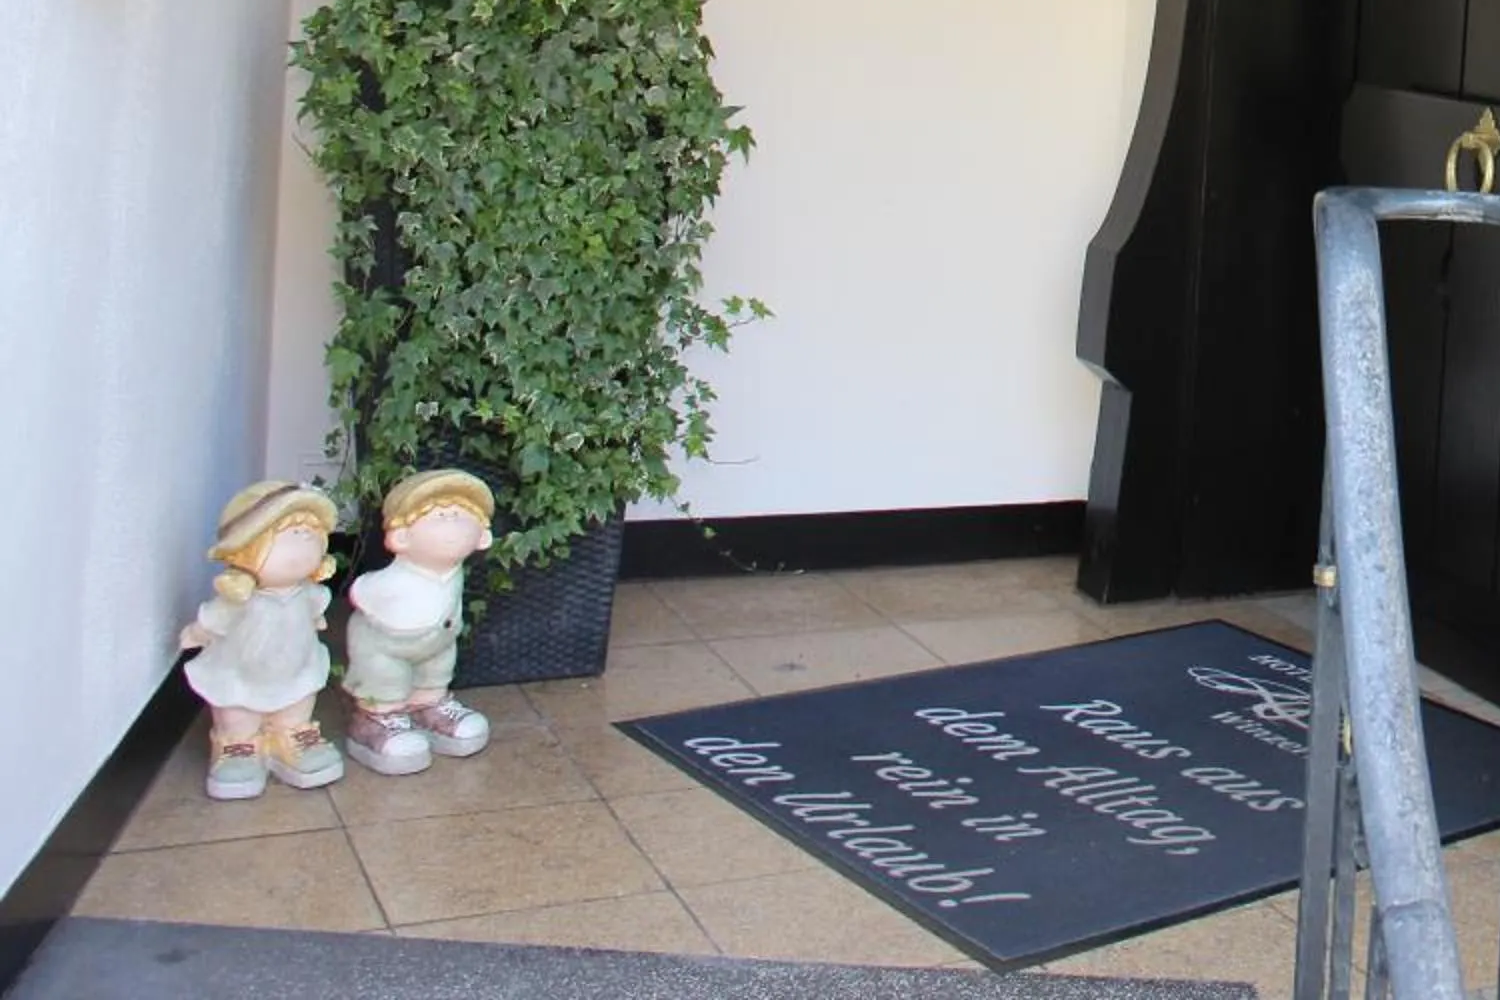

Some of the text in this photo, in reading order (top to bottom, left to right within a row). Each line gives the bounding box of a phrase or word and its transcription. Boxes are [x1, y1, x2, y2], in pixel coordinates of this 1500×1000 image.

[850, 751, 1048, 842] rein in
[914, 706, 1217, 856] dem Alltag,
[1039, 699, 1305, 812] Raus aus
[683, 737, 1032, 908] den Urlaub!
